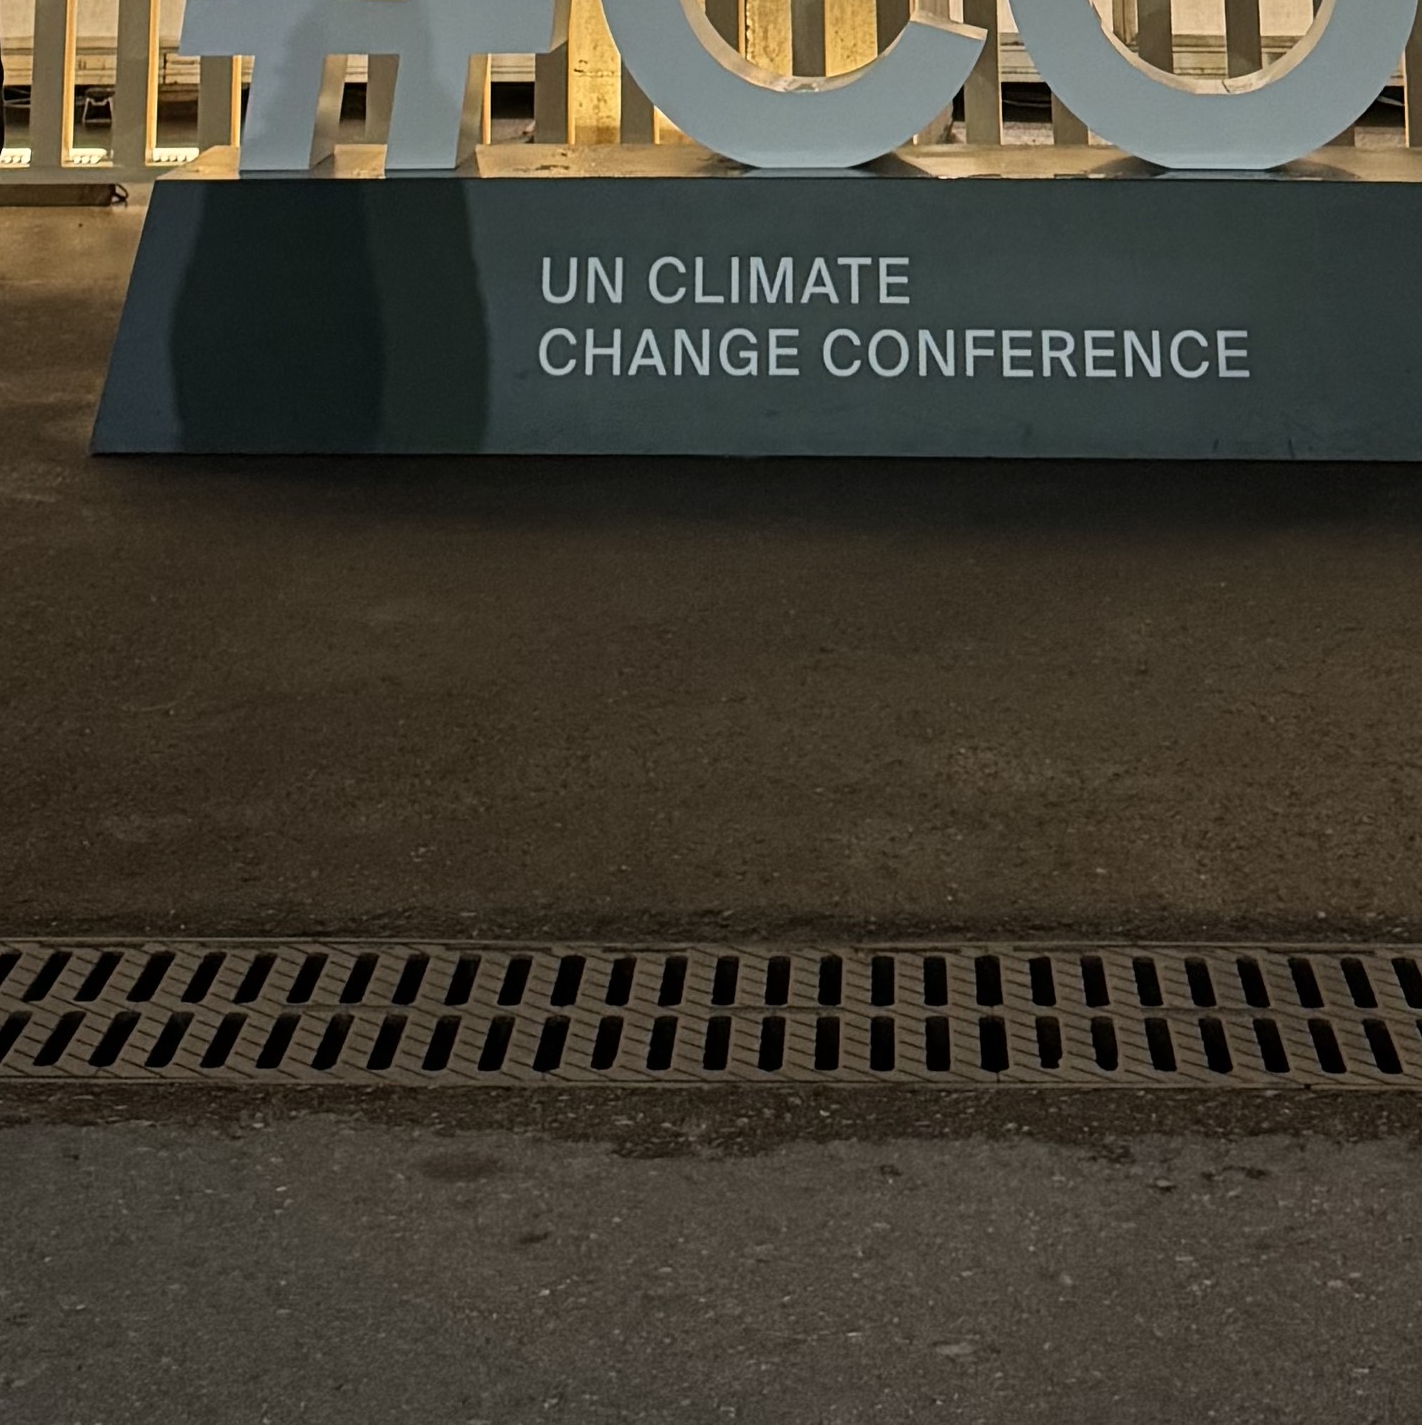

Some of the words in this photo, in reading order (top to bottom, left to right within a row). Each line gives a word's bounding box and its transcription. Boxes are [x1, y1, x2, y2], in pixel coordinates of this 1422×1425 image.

[541, 255, 624, 304] UN
[646, 255, 911, 305] CLIMATE
[538, 327, 801, 377] CHANGE
[821, 327, 1252, 379] CONFERENCE
